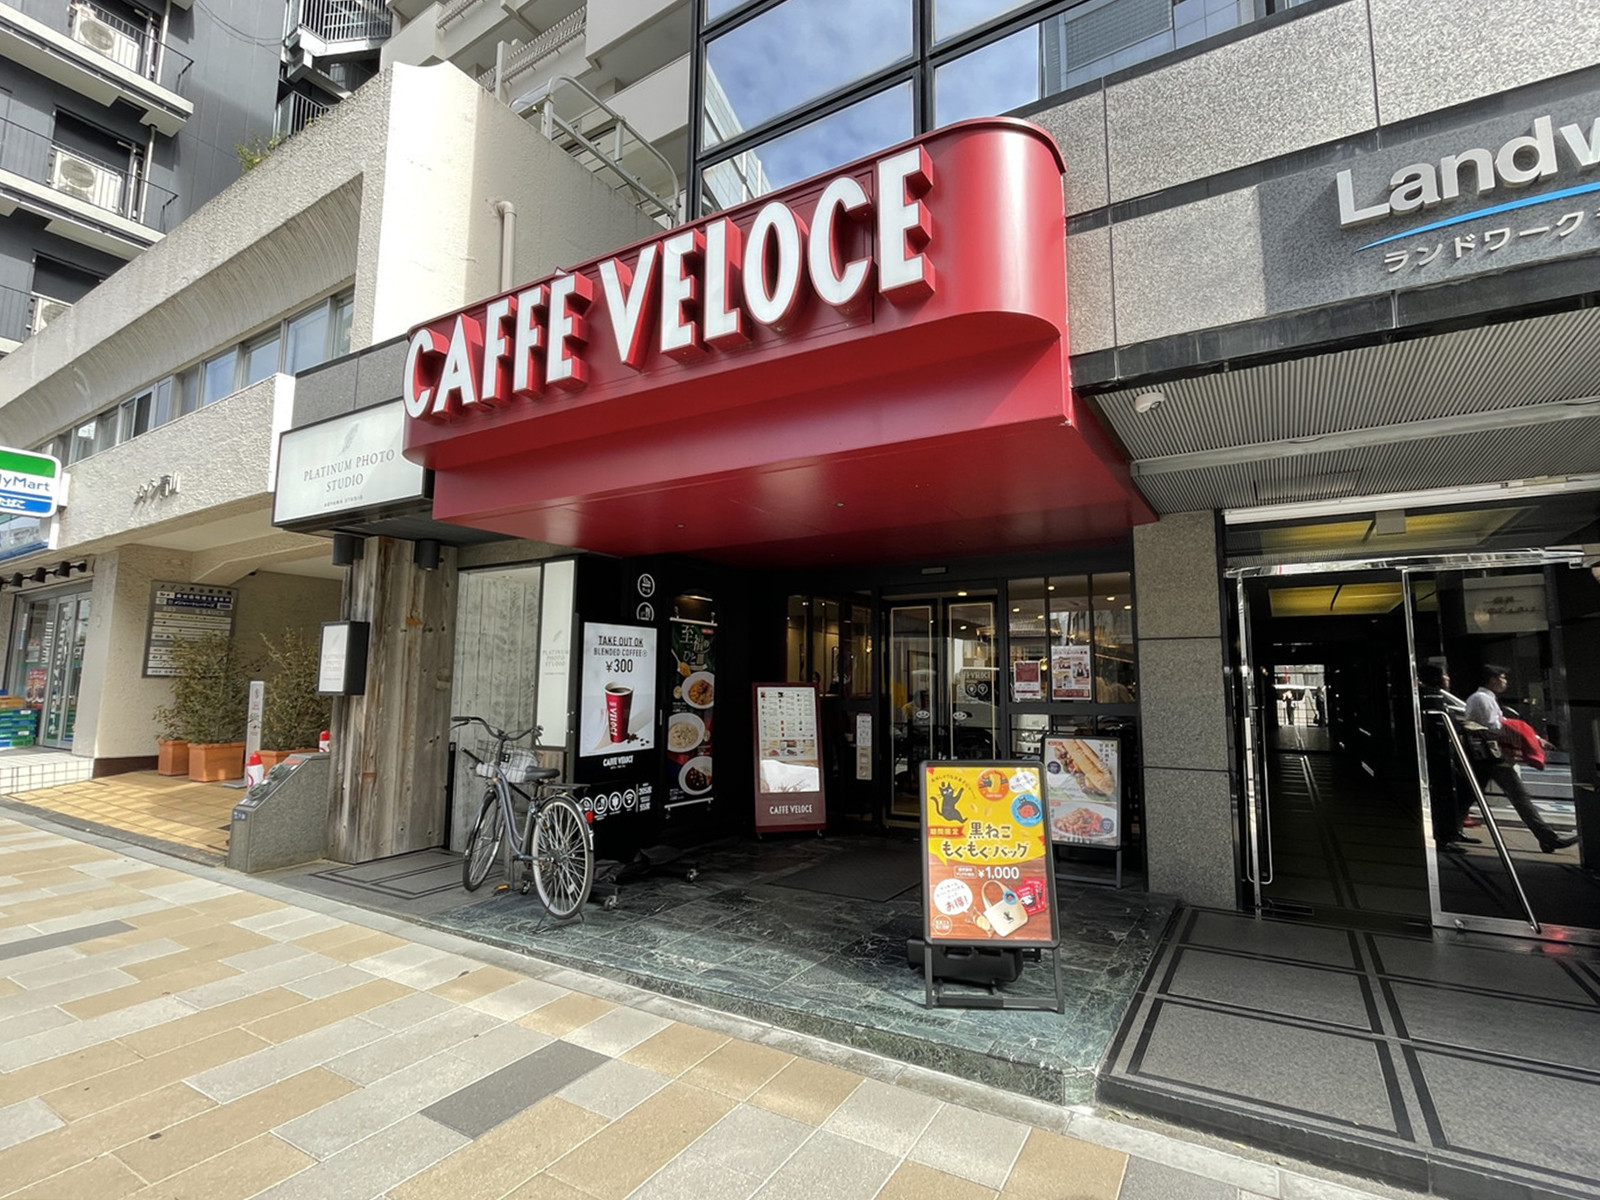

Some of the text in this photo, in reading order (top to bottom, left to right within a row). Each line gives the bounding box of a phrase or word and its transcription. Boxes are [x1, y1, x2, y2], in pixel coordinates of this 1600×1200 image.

[1384, 208, 1600, 274] ランドワーク
[599, 144, 935, 370] VELOCE
[303, 448, 396, 482] PLATINUM PHOTO
[325, 472, 364, 493] STUDIO
[598, 635, 644, 647] TAKE OUT OK
[593, 647, 621, 657] BLENDED
[605, 658, 633, 673] ¥300
[769, 803, 813, 815] CAFFE VELOCE
[968, 821, 1012, 840] 黒ねこ
[942, 840, 1030, 860] もぐもぐバッグ
[977, 866, 1020, 880] ¥1,000
